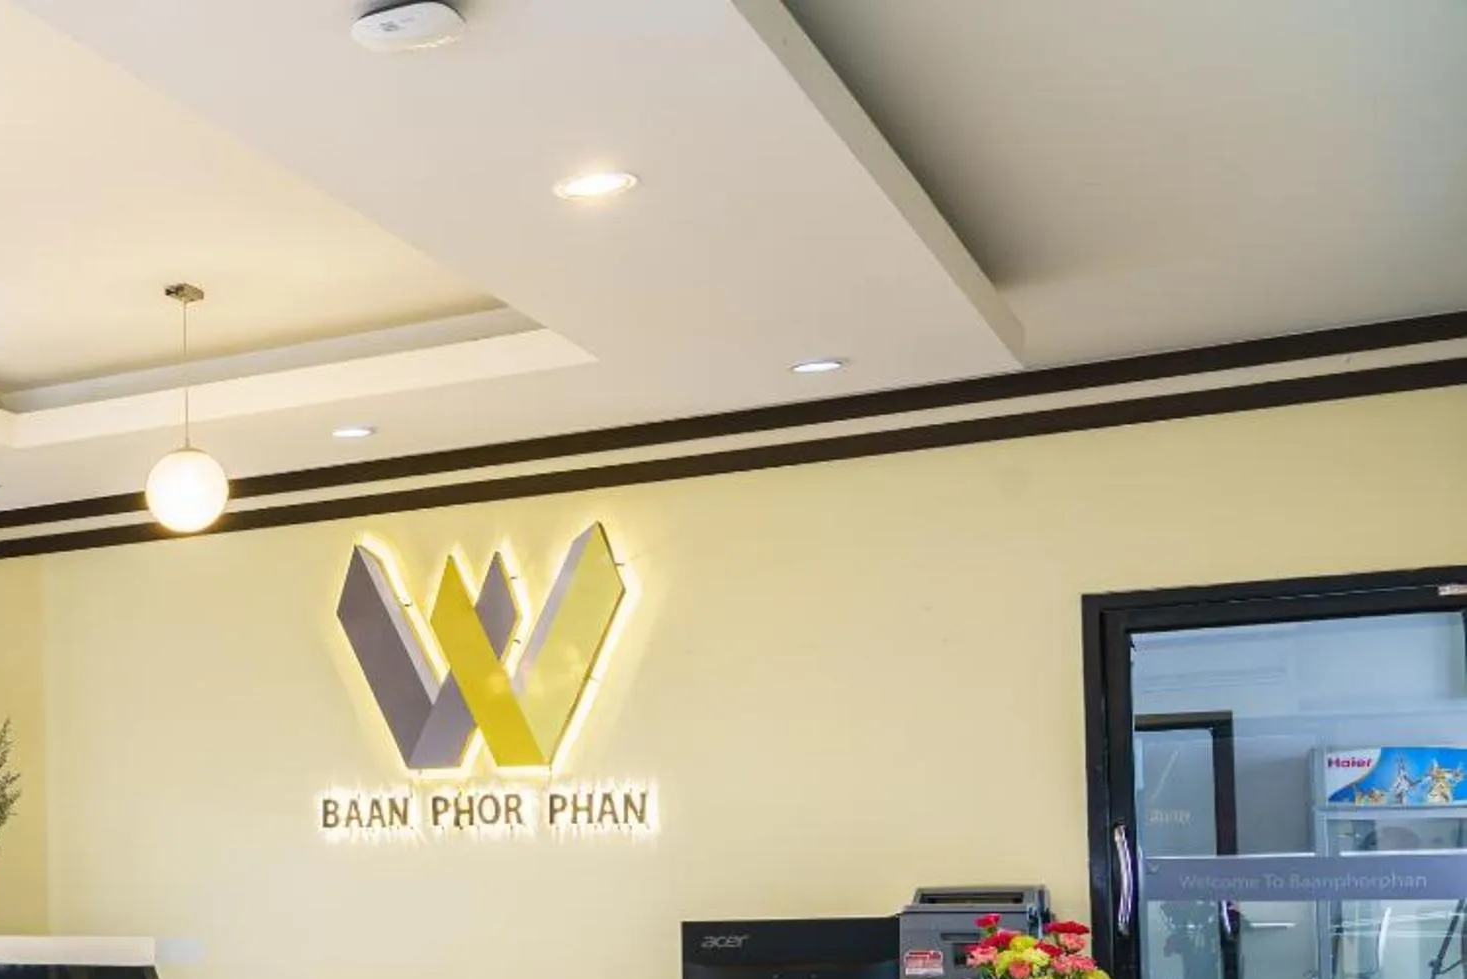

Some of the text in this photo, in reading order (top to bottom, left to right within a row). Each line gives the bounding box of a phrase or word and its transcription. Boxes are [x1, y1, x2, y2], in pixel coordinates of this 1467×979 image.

[1327, 757, 1372, 768] Haier
[321, 791, 648, 829] BAAN PHOR PHAN
[1179, 873, 1259, 889] Welcome
[1262, 873, 1284, 889] To
[700, 934, 751, 949] acer
